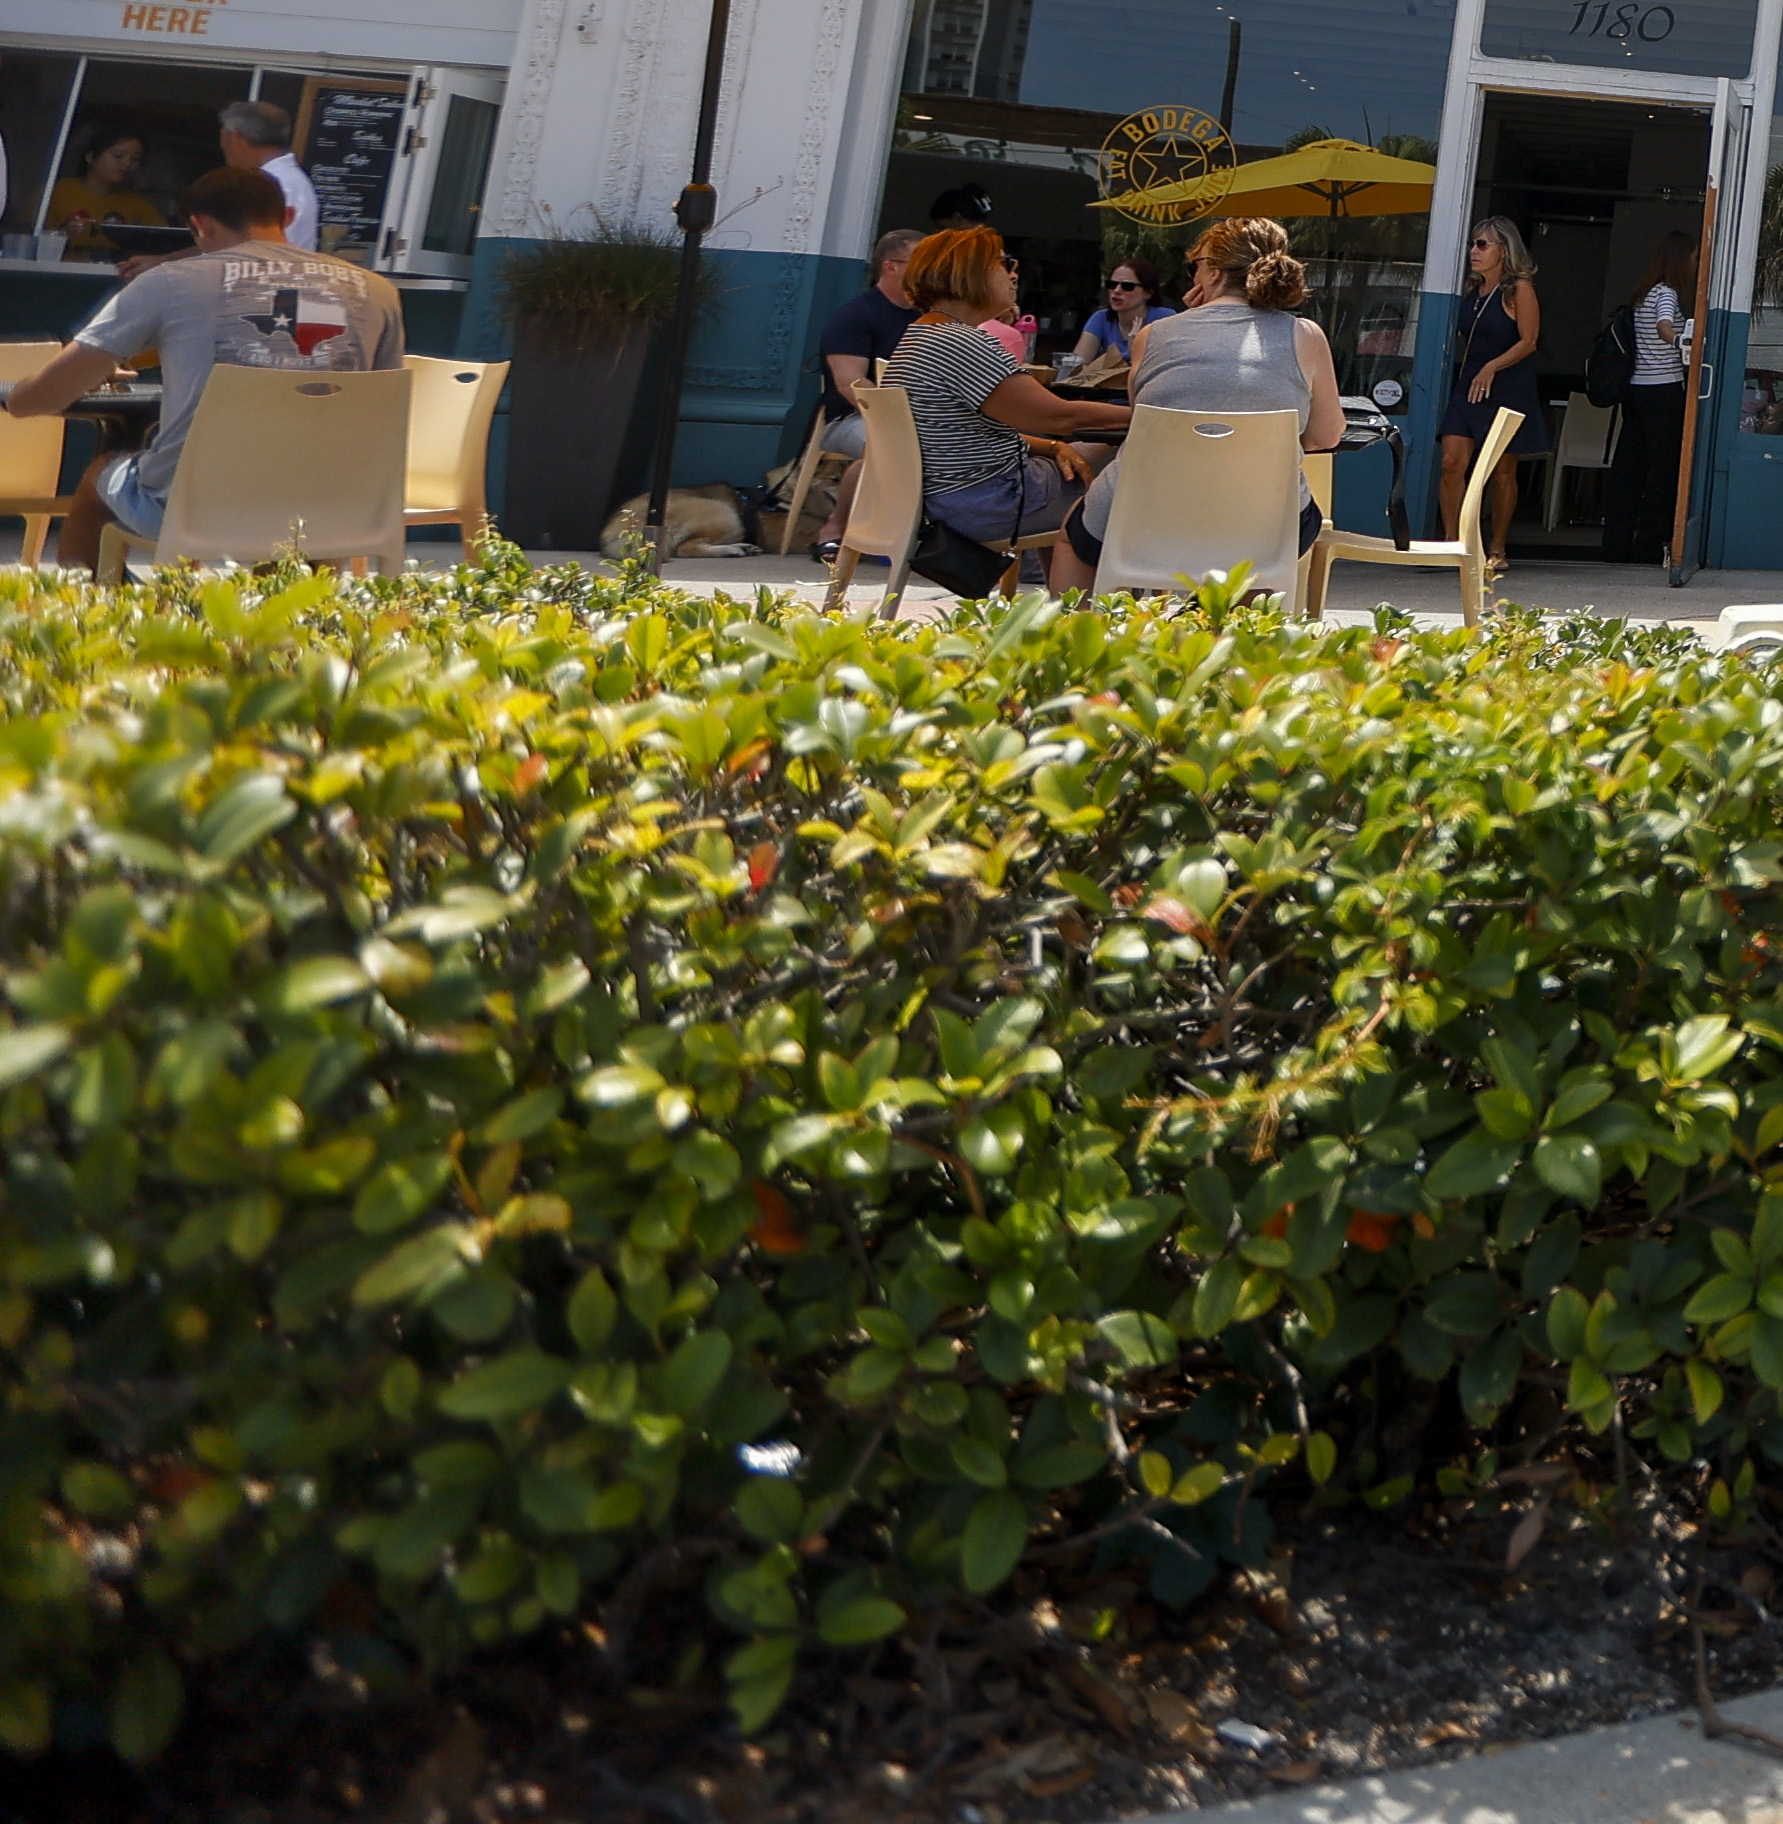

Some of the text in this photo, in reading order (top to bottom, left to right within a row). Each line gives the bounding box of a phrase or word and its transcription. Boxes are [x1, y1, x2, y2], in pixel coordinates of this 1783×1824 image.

[122, 4, 212, 35] HERE
[1569, 0, 1674, 43] 1180
[1122, 109, 1226, 152] BODEGA
[1106, 148, 1129, 179] EAT
[1118, 188, 1182, 221] DRINK
[1194, 164, 1231, 212] JUICE
[223, 261, 294, 282] BILLY
